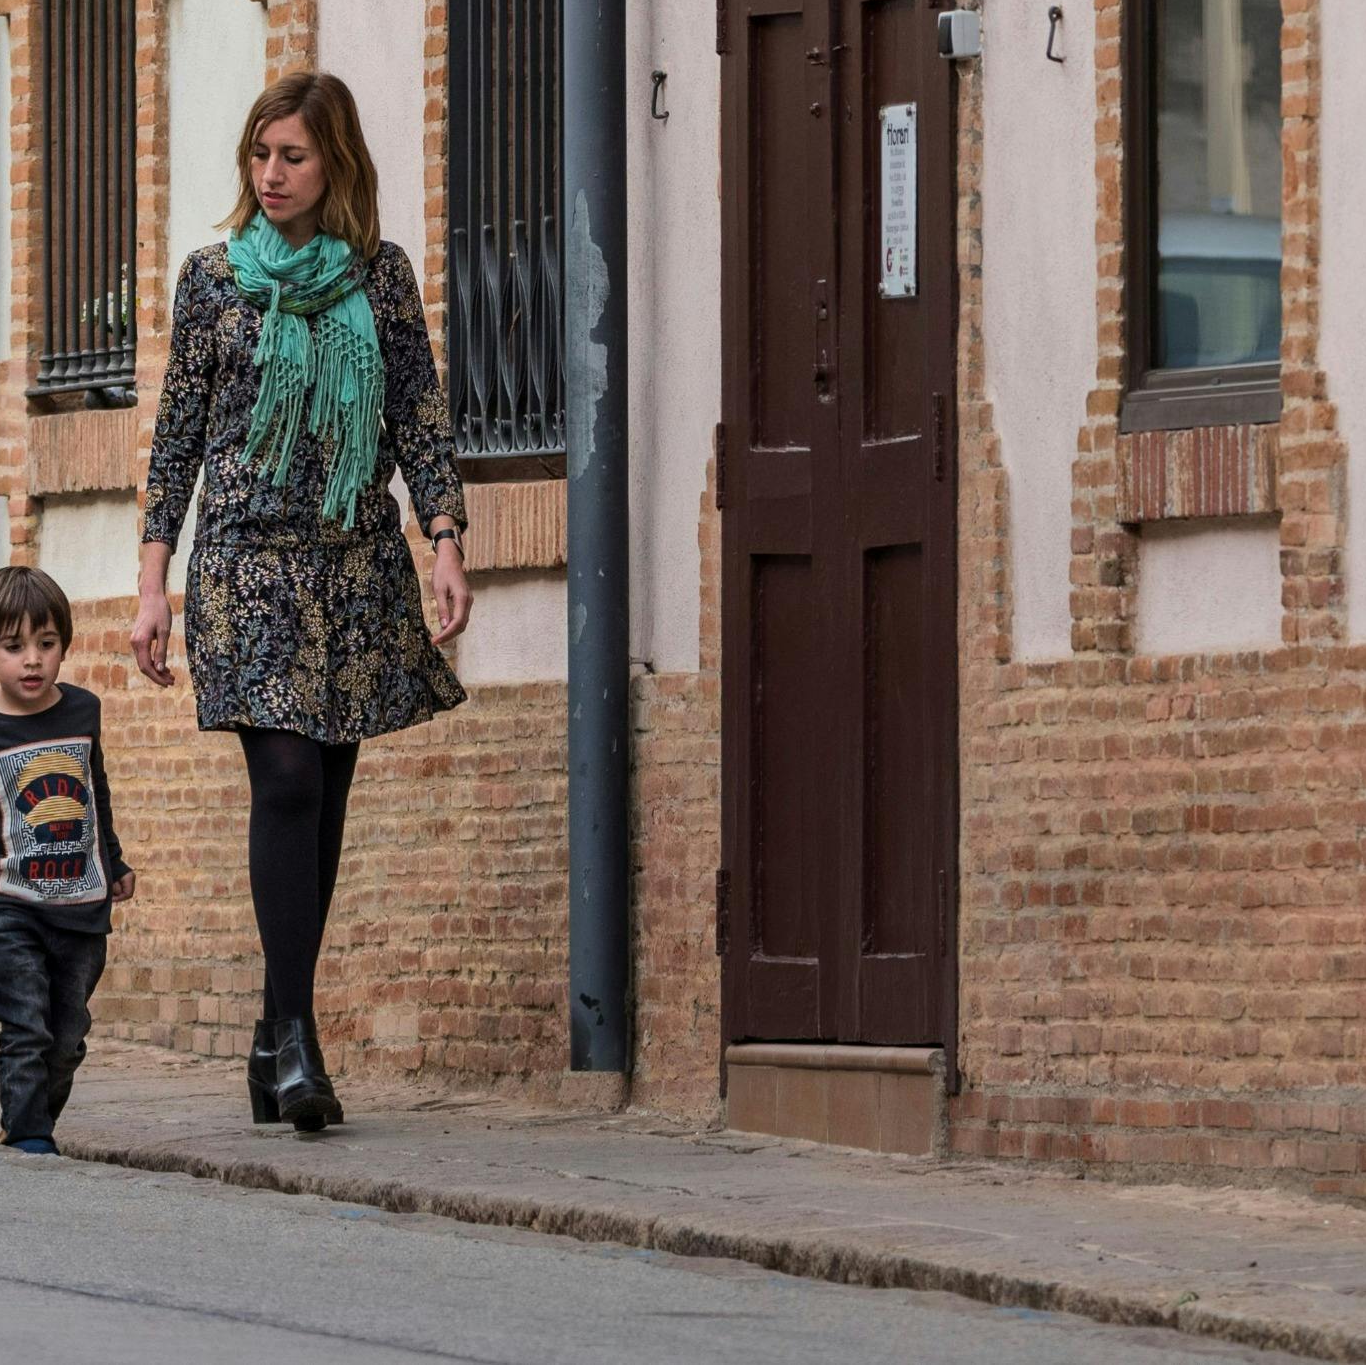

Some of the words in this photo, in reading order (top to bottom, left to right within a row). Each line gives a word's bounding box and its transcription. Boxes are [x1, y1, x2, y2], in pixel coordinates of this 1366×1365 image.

[887, 123, 910, 146] Horari
[24, 778, 82, 806] RIDE
[29, 858, 84, 880] ROCK
